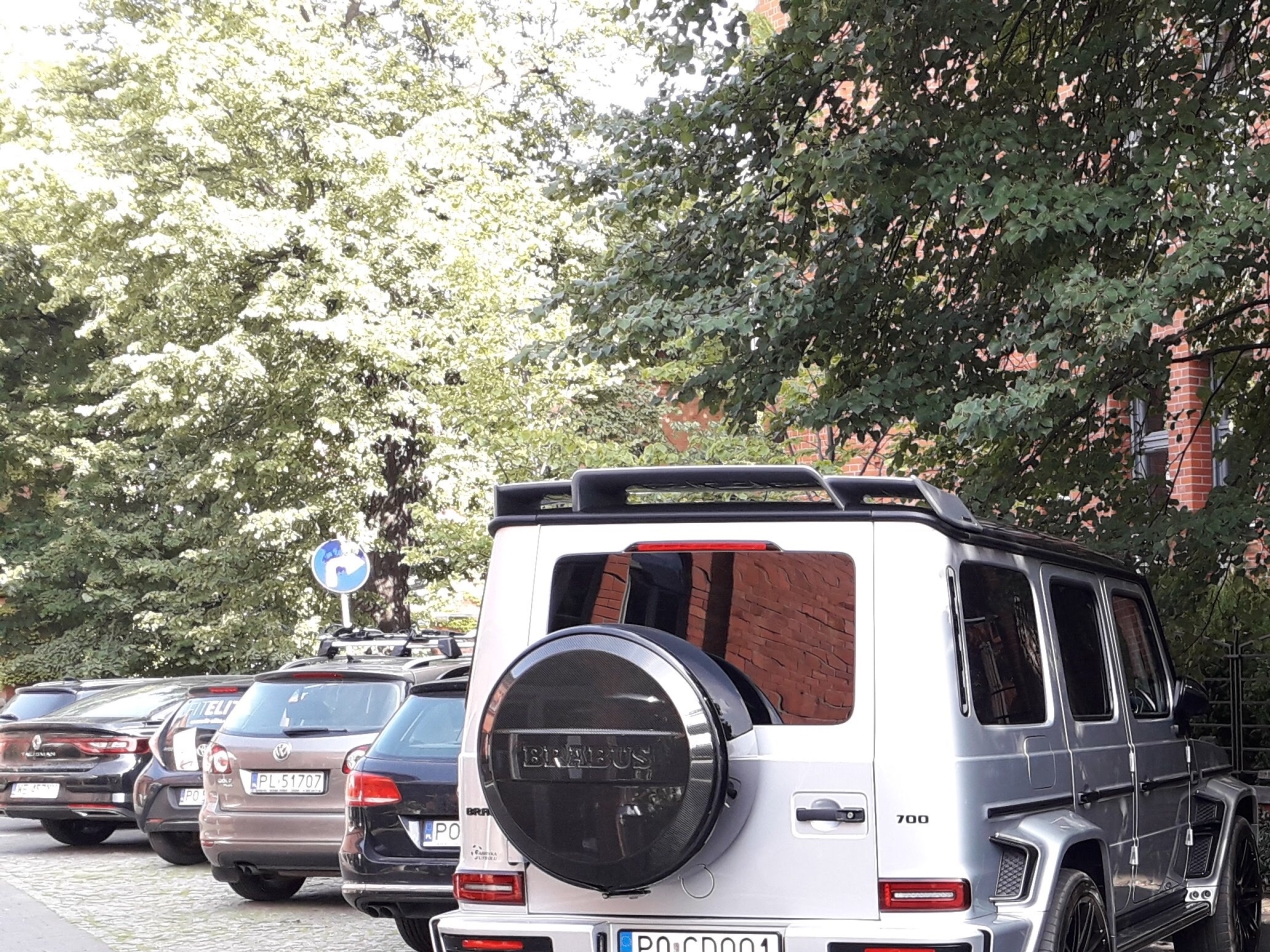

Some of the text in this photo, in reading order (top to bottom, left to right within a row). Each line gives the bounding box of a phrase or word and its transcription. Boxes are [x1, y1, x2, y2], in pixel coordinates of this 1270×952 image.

[523, 745, 651, 769] BRABUS
[259, 774, 276, 788] PL
[281, 774, 322, 788] 51707
[185, 790, 200, 801] PO
[896, 814, 929, 824] 700
[435, 823, 460, 840] PO
